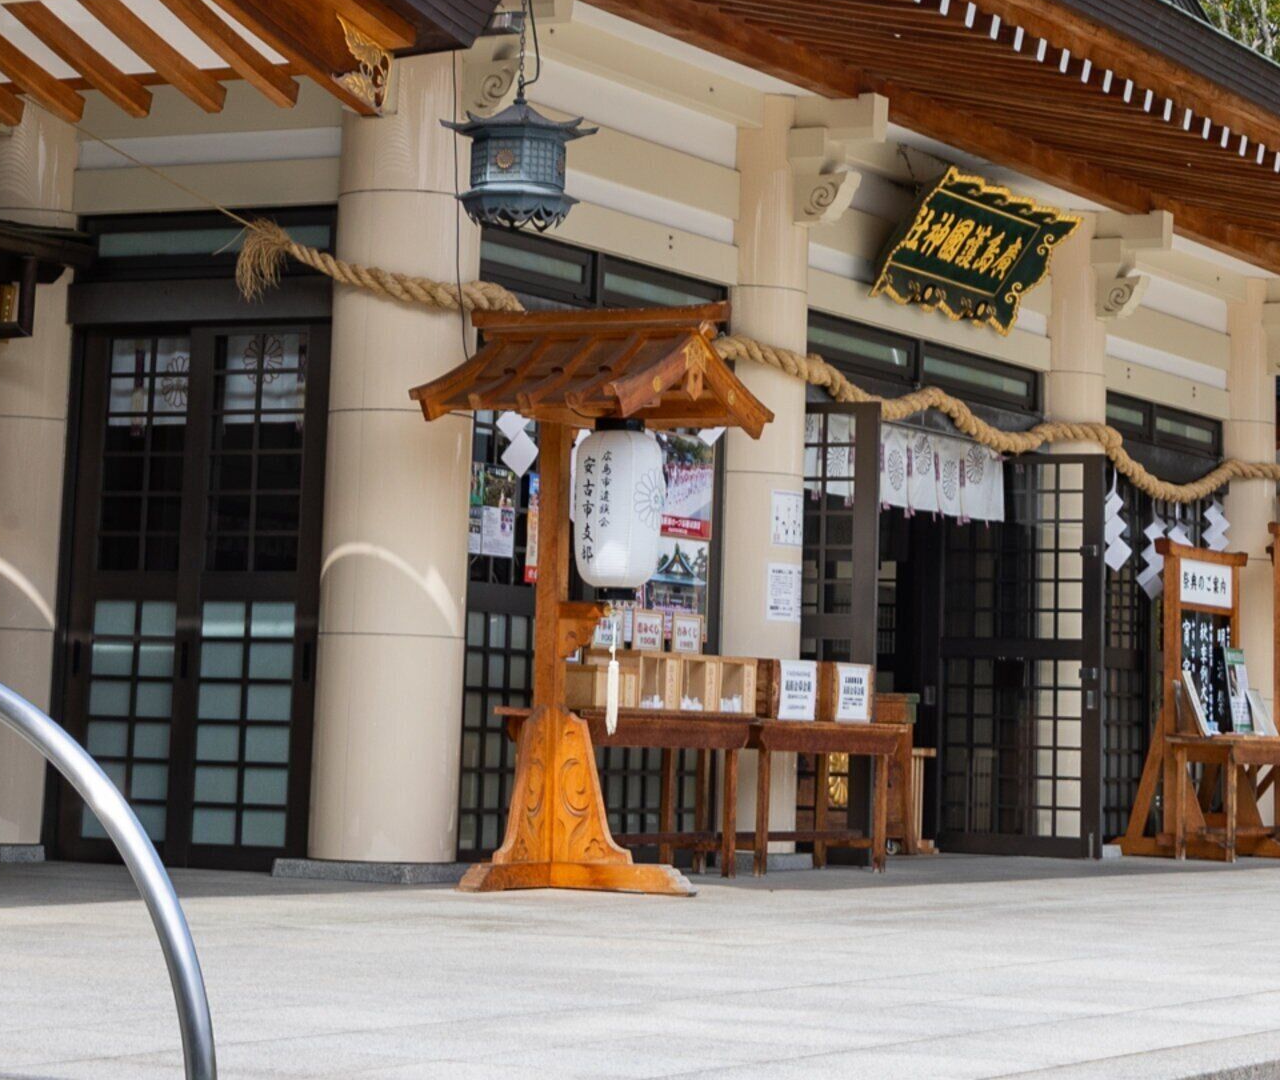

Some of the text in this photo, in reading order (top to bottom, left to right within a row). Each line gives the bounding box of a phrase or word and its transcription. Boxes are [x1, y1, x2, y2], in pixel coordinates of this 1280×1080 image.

[580, 455, 597, 563] 安古市支部
[598, 450, 613, 528] 広島市遺族会
[1182, 571, 1227, 596] 祭典のご案内
